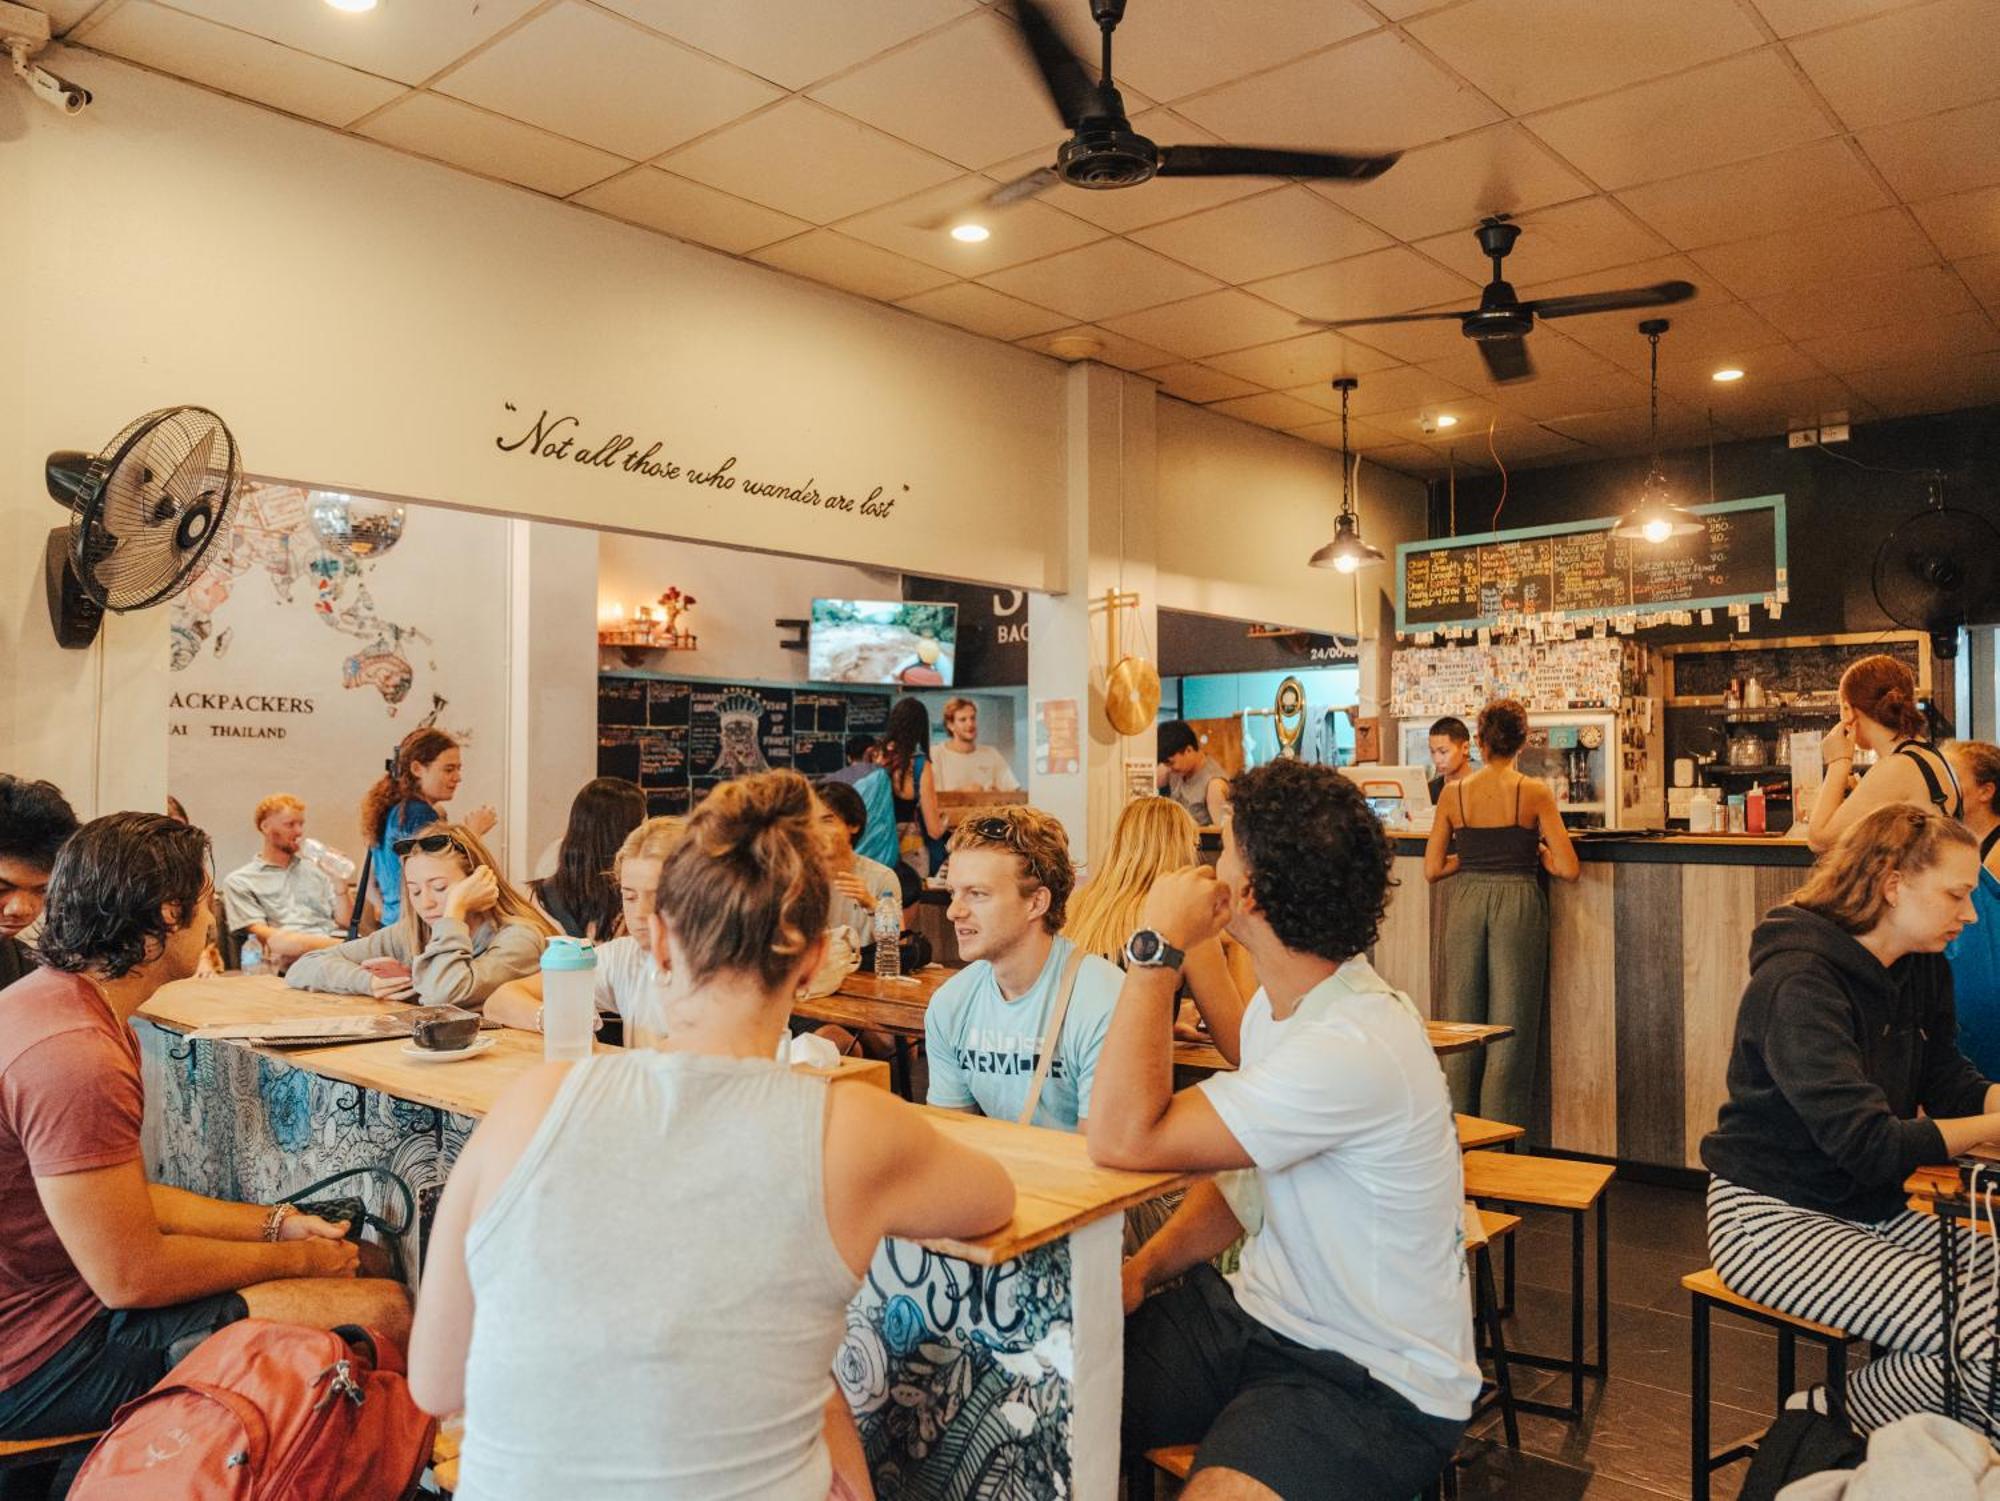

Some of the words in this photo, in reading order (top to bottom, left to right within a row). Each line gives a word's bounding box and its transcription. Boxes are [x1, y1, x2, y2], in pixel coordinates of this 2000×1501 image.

[575, 435, 626, 469] all
[623, 441, 680, 480] those
[687, 456, 736, 490] who
[743, 477, 821, 507] wander
[825, 493, 855, 513] are
[169, 692, 315, 714] ACKPACKERS
[210, 725, 287, 739] THAILAND
[957, 1049, 1068, 1079] ARMOR
